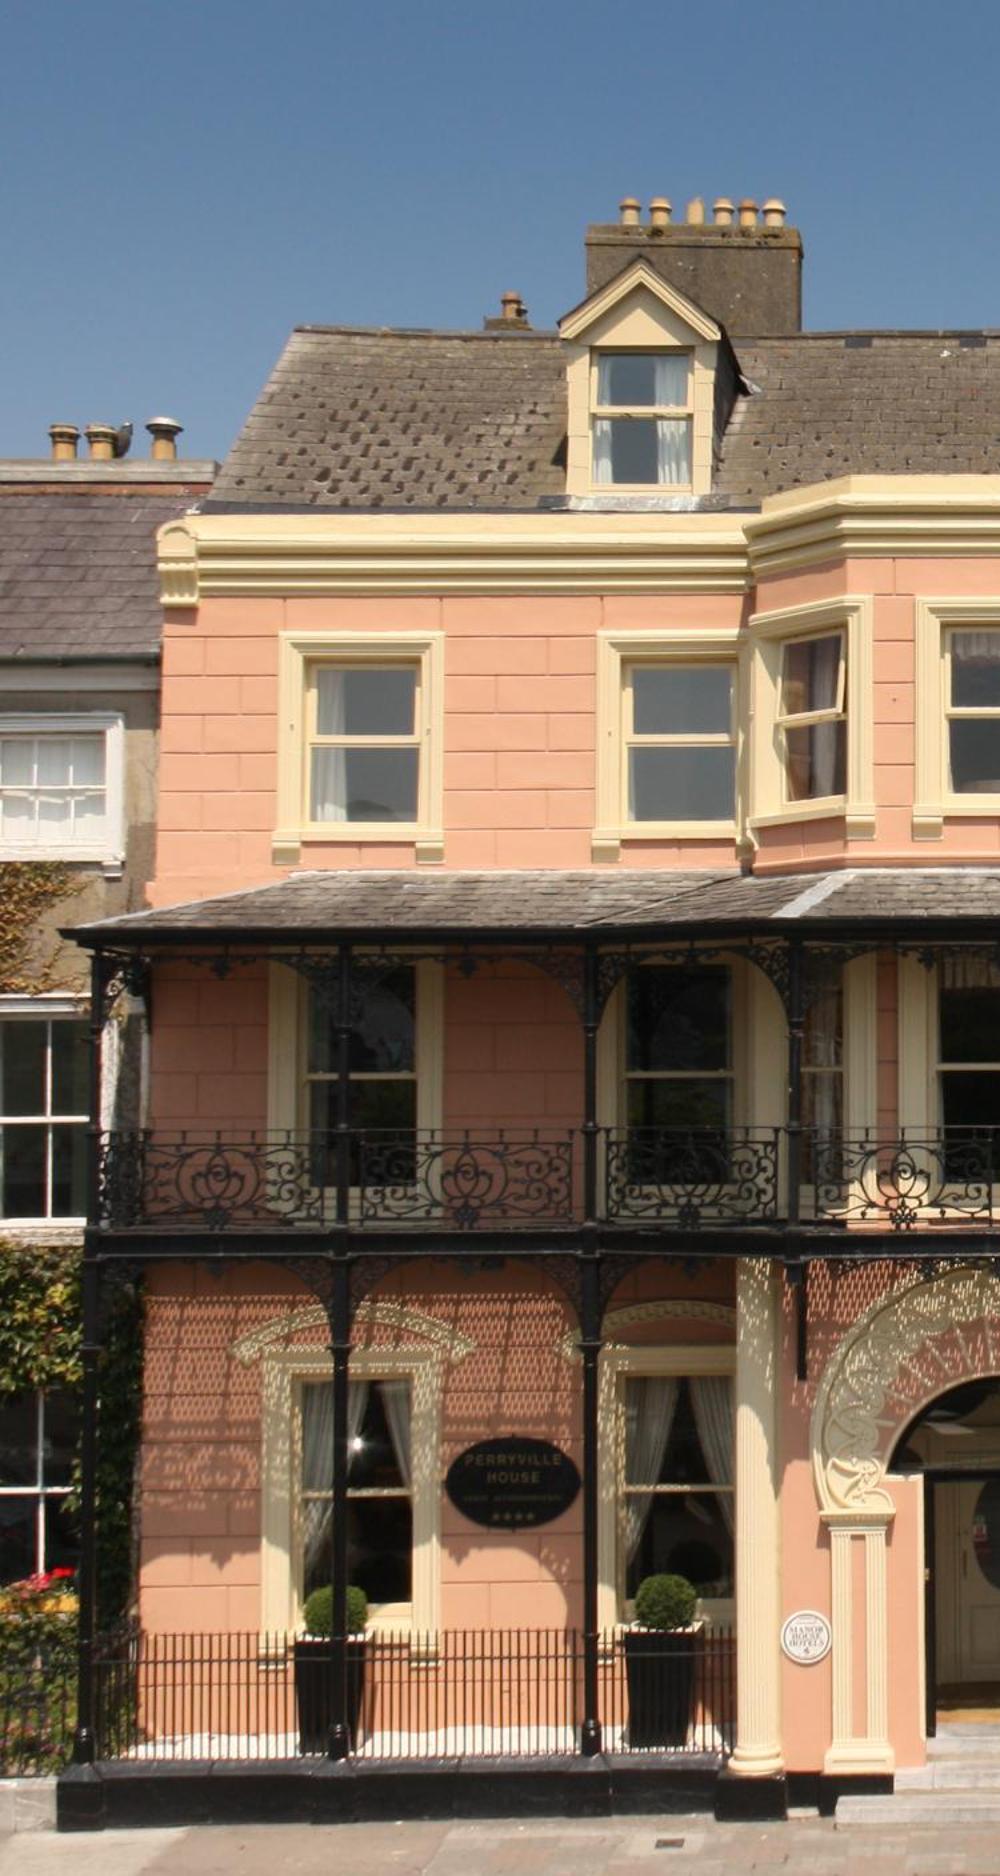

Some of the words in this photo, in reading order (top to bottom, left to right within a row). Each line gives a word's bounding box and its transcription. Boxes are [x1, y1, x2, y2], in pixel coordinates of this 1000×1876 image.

[464, 1453, 562, 1466] PERRYVILLE
[486, 1471, 541, 1484] HOUSE
[789, 1639, 825, 1647] HOTELS
